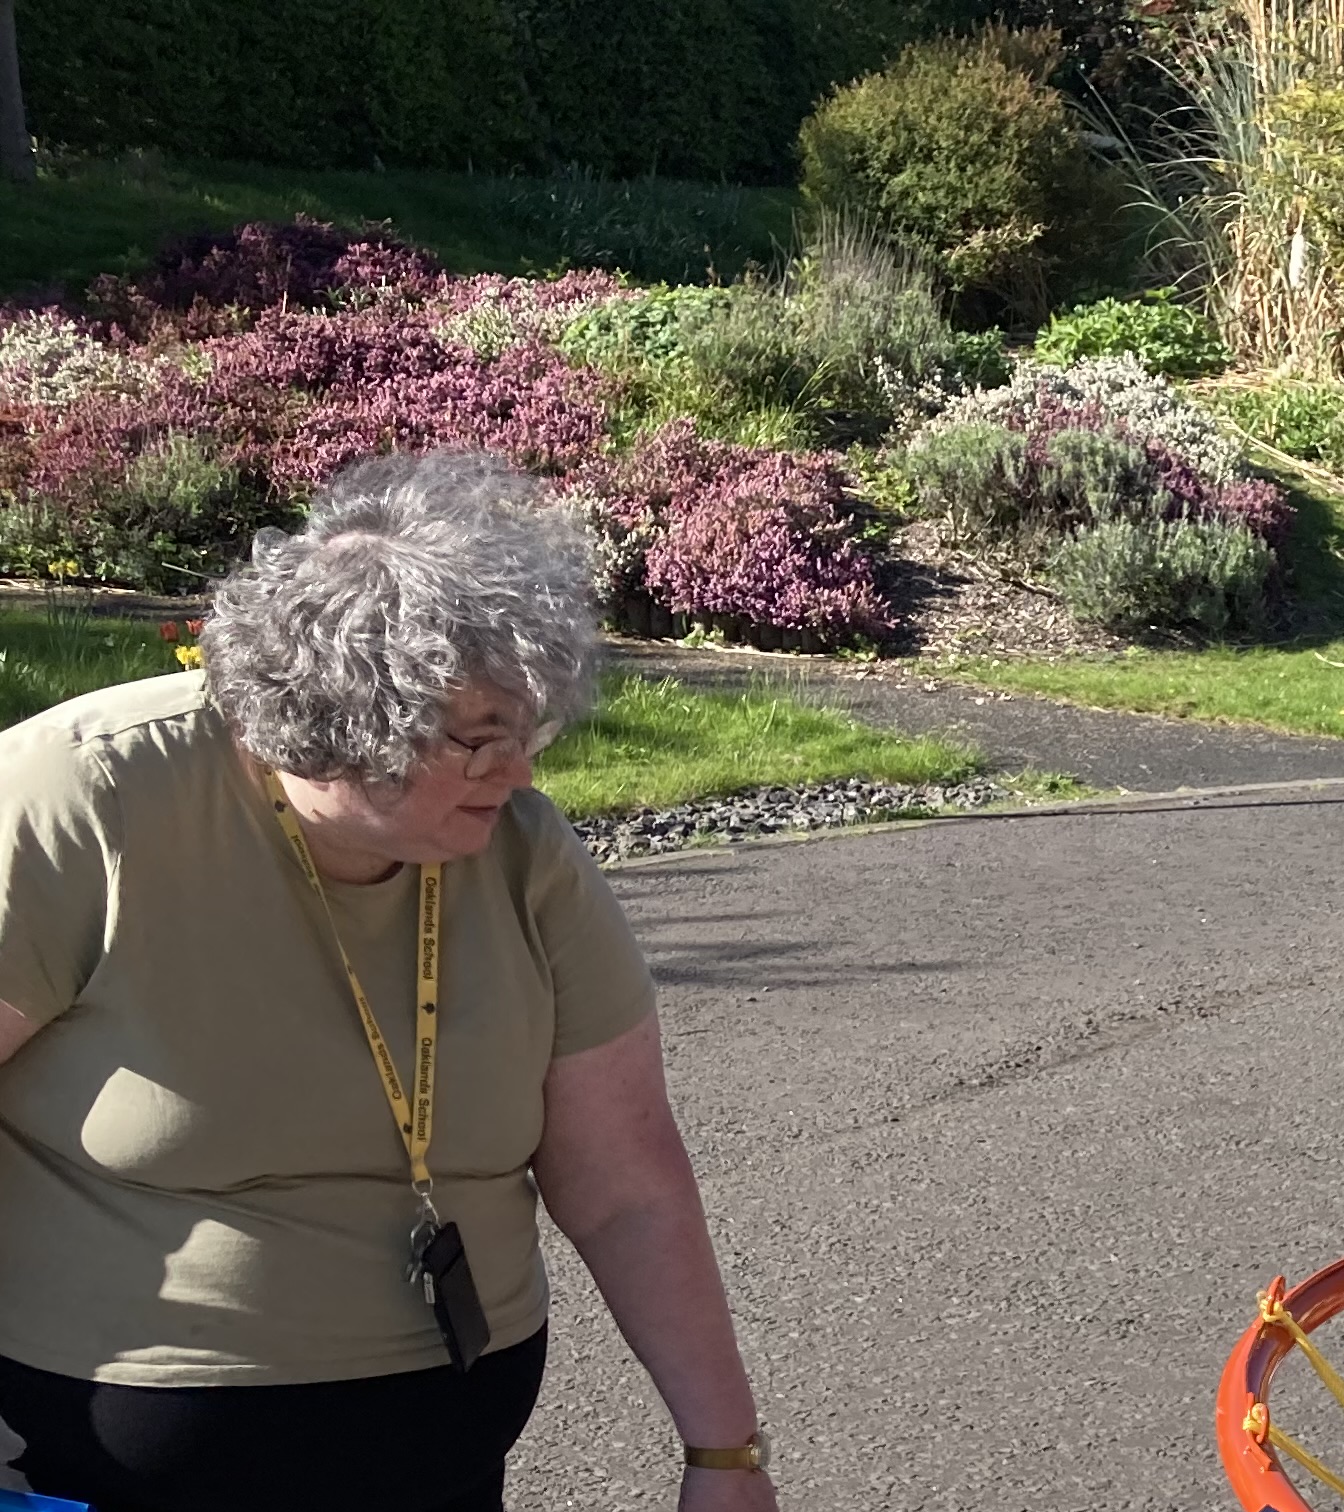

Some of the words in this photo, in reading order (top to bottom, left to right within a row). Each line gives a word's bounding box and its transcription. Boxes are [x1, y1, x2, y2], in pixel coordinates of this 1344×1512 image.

[423, 876, 438, 934] Oaklands
[422, 937, 436, 980] School
[378, 1043, 402, 1100] Oaklands
[419, 1036, 433, 1095] Oaklands
[417, 1097, 430, 1143] School
